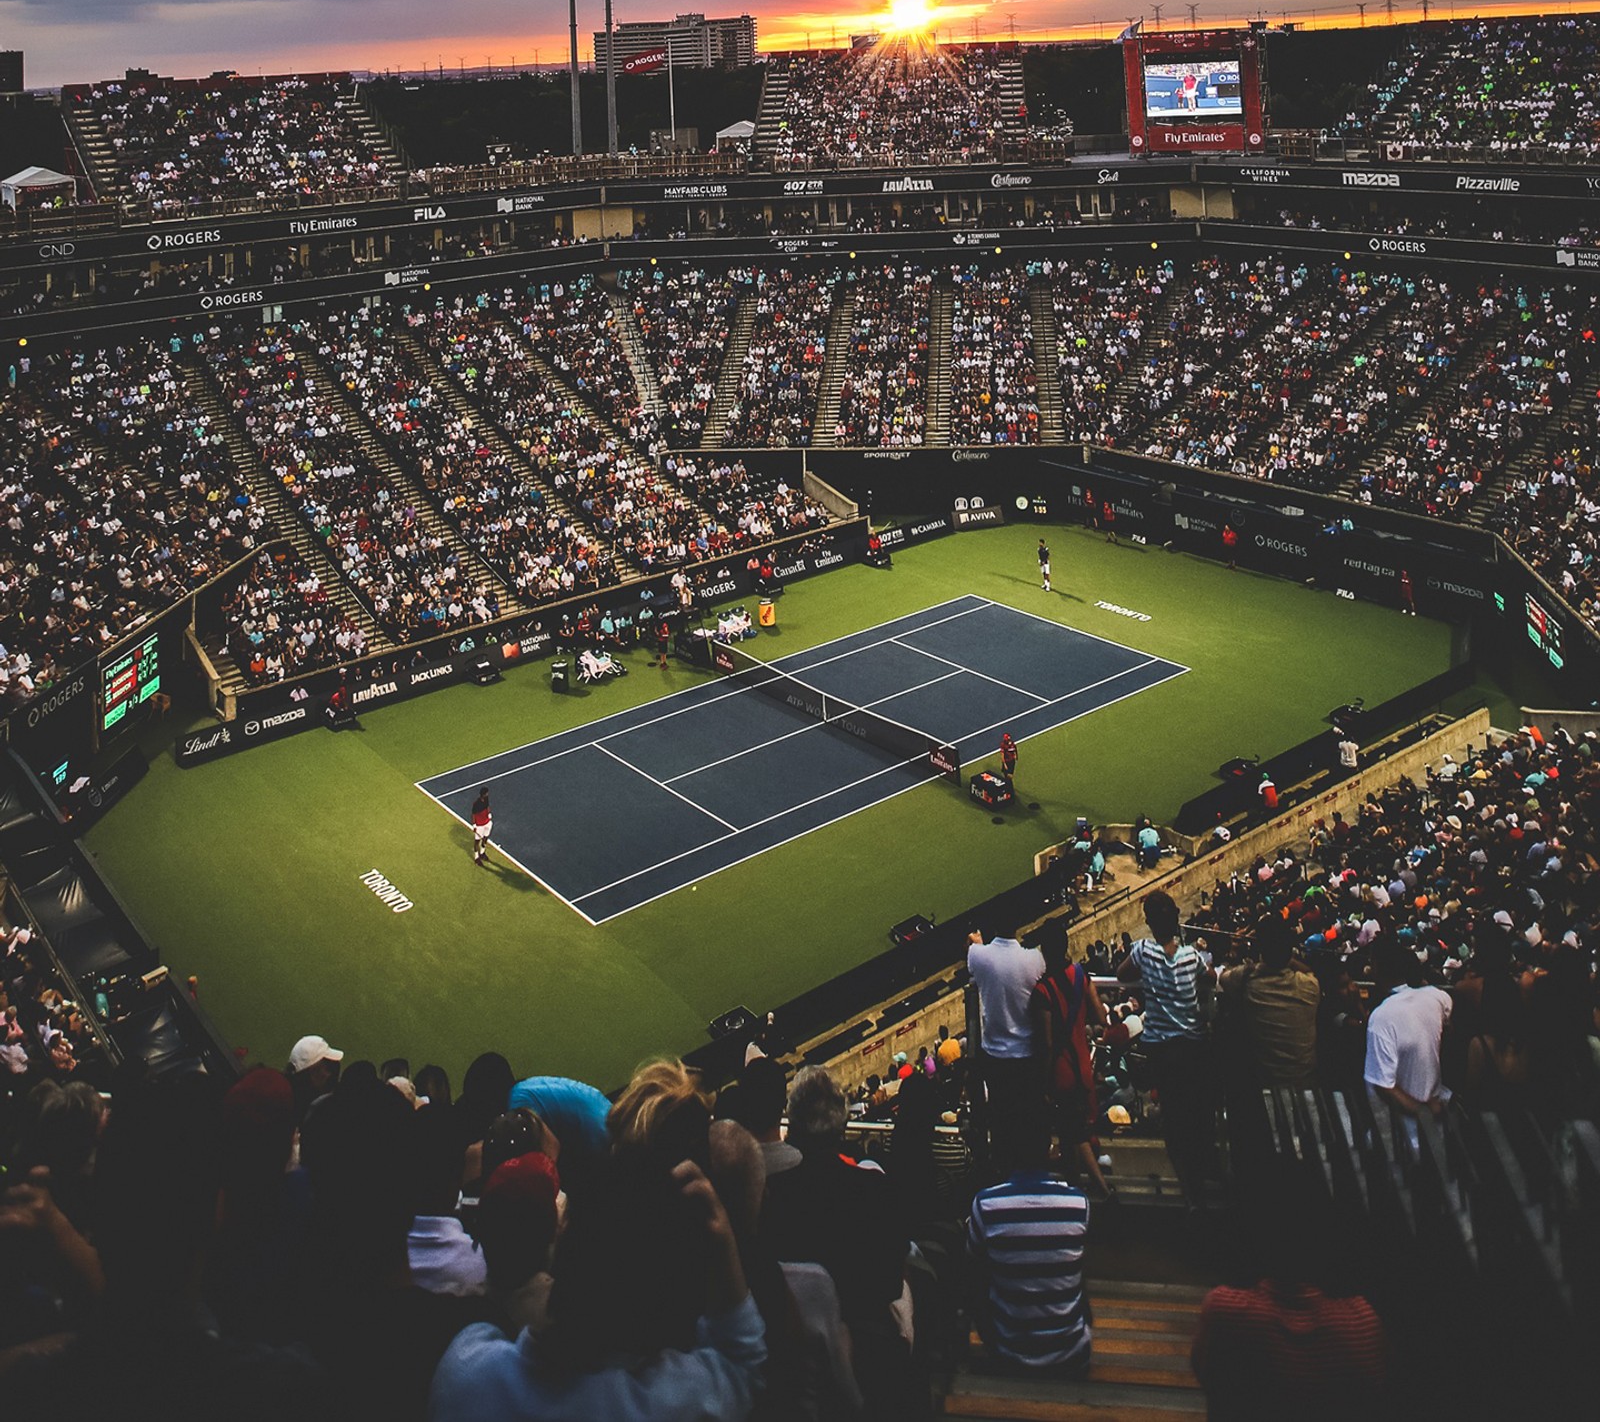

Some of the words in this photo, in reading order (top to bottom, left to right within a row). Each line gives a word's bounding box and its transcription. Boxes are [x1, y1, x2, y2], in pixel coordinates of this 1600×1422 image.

[1165, 133, 1181, 145] Fly
[1182, 132, 1224, 143] Emirates
[1098, 169, 1119, 184] Stoli
[1240, 168, 1290, 177] CALIFORNIA
[664, 186, 699, 195] MAYFAIR
[700, 185, 728, 194] CLUBS
[784, 181, 806, 191] 407
[882, 177, 934, 193] LAVAZZA
[1456, 176, 1520, 192] Pizzaville
[515, 196, 545, 205] NATIONAL
[414, 206, 446, 221] FILA
[290, 222, 308, 234] Fly
[310, 218, 357, 231] Emirates
[165, 230, 221, 247] ROGERS
[39, 243, 75, 258] CND
[1382, 240, 1426, 253] ROGERS
[1578, 260, 1599, 268] BANK
[402, 269, 430, 278] NATIONAL
[216, 291, 263, 306] ROGERS
[970, 511, 996, 521] AVIVA
[1132, 534, 1147, 545] FILA
[1267, 538, 1308, 557] ROGERS
[773, 561, 806, 578] Canada
[701, 580, 736, 598] ROGERS
[1336, 588, 1355, 600] FILA
[1094, 600, 1152, 622] TORONTO
[520, 633, 551, 647] NATIONAL
[522, 643, 541, 654] BANK
[411, 671, 431, 685] JACK
[42, 676, 84, 717] ROGERS
[353, 682, 398, 704] LAVAZZA
[787, 694, 804, 707] ATP
[841, 718, 867, 738] TOUR
[182, 732, 220, 755] Lindt
[971, 784, 993, 804] FedEx
[359, 868, 413, 913] TORONTO
